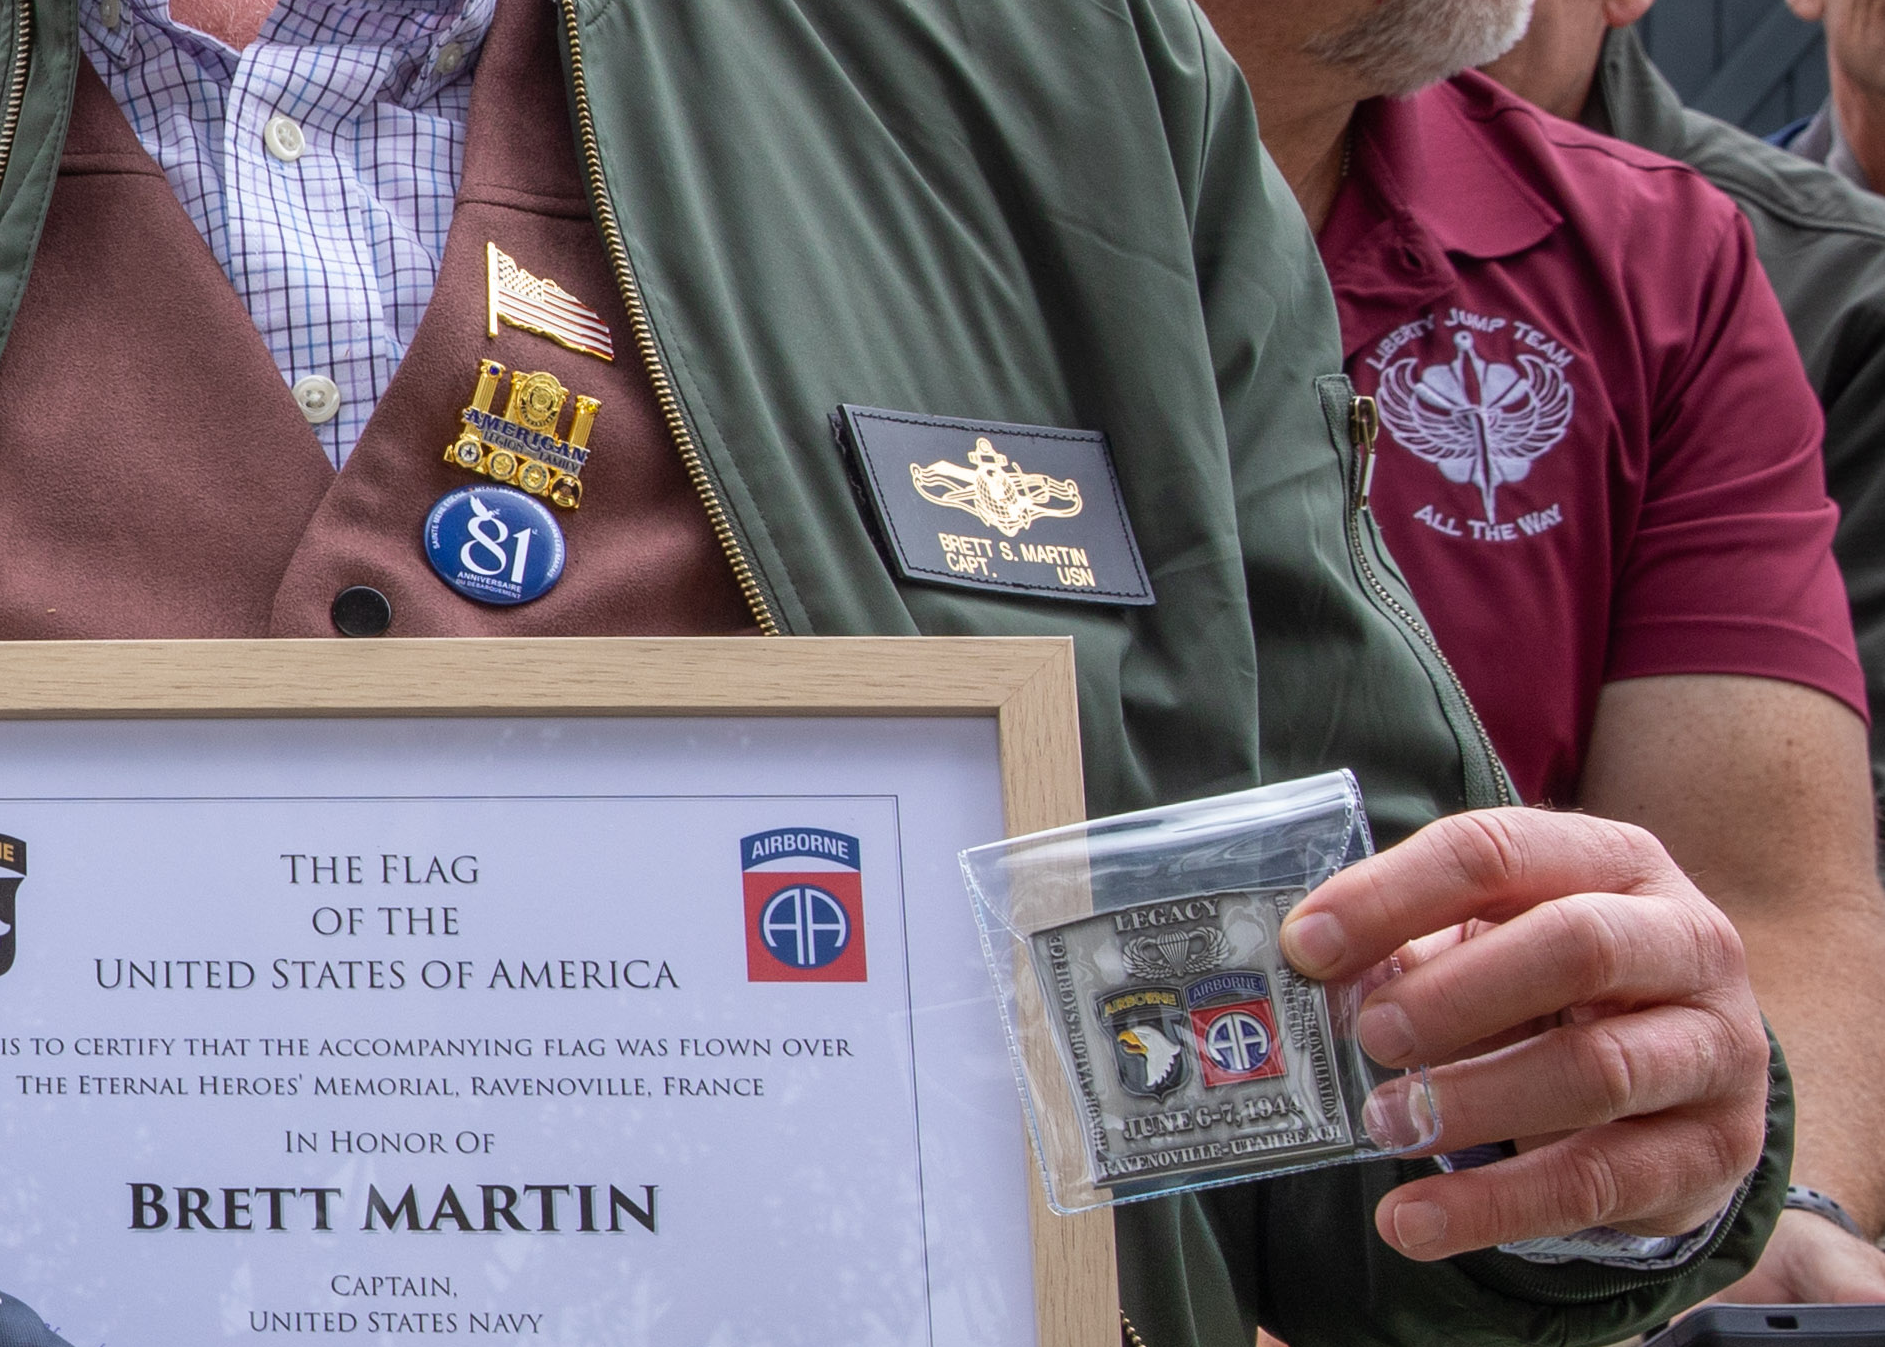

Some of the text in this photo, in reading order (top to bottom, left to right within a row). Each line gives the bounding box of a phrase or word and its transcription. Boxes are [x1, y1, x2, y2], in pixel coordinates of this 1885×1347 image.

[1365, 307, 1574, 369] LIBERTY JUMP TEAM
[463, 408, 589, 465] AMERICAN
[1413, 504, 1563, 542] ALL THE WAY
[938, 533, 1088, 567] BRETT S. MARTIN
[947, 555, 998, 578] CAPT.
[1057, 567, 1096, 587] USN
[457, 571, 523, 594] ANNIVERSAIRE
[751, 834, 849, 860] AIRBORNE
[280, 854, 478, 884] THE FLAG
[312, 906, 459, 936] OF THE
[1115, 899, 1220, 932] LEGACY
[94, 958, 679, 990] UNITED STATES OF AMERICA
[1049, 934, 1079, 1028] SACRIFICE
[1193, 976, 1263, 1002] AIRBORNE
[1104, 991, 1177, 1017] AIRBORNE
[1, 1037, 20, 1056] IS
[29, 1037, 65, 1056] TO
[74, 1037, 175, 1056] CERTIFY
[183, 1038, 251, 1057] THAT
[259, 1038, 309, 1057] THE
[318, 1038, 532, 1057] ACCOMPANYING
[544, 1038, 605, 1057] FLAG
[616, 1038, 668, 1057] WAS
[679, 1038, 771, 1057] FLOWN
[782, 1038, 854, 1057] OVER
[15, 1073, 764, 1097] THE ETERNAL HEROES' MEMORIAL, RAVENOVILLE, FRANCE
[1124, 1110, 1193, 1139] JUNE
[1244, 1092, 1303, 1121] 1944
[285, 1130, 495, 1154] IN HONOR OF
[126, 1182, 659, 1233] BRETT MARTIN
[330, 1275, 457, 1298] CAPTAIN,
[249, 1310, 543, 1334] UNITED STATES NAVY
